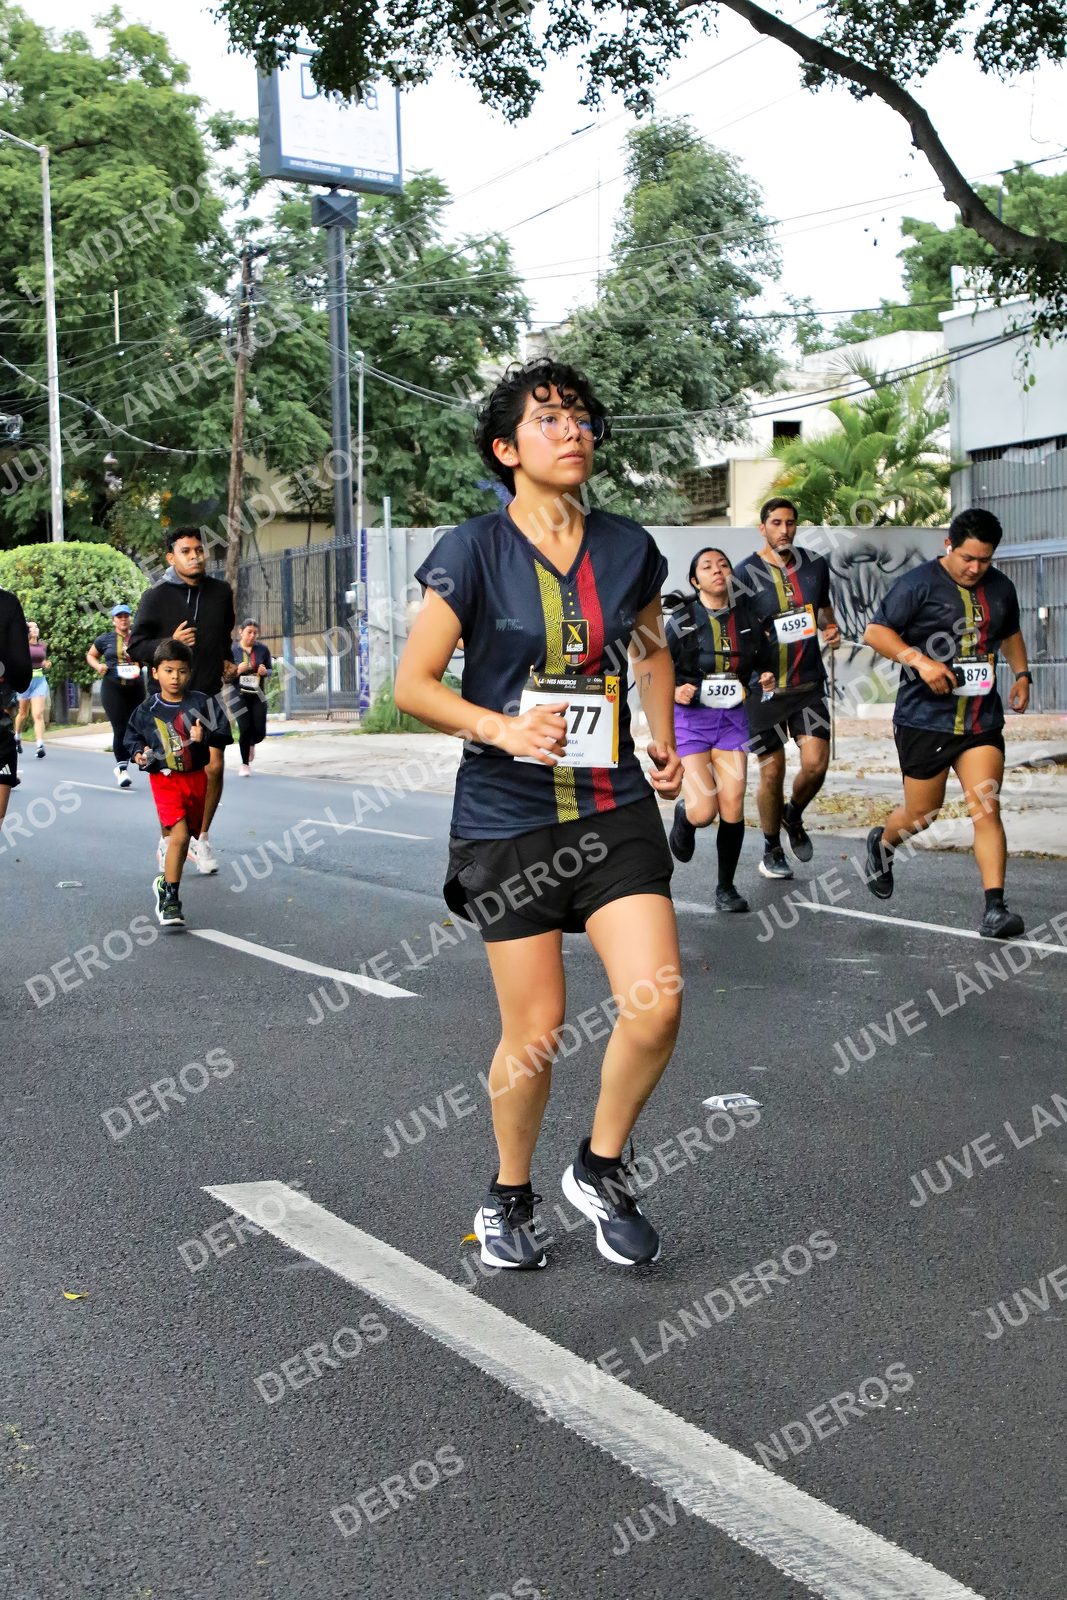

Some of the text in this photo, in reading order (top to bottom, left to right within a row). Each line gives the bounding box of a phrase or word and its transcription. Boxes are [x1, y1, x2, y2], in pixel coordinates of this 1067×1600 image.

[781, 617, 808, 632] 4595
[964, 668, 988, 682] 879
[606, 684, 616, 694] 5K
[707, 685, 736, 696] 5305
